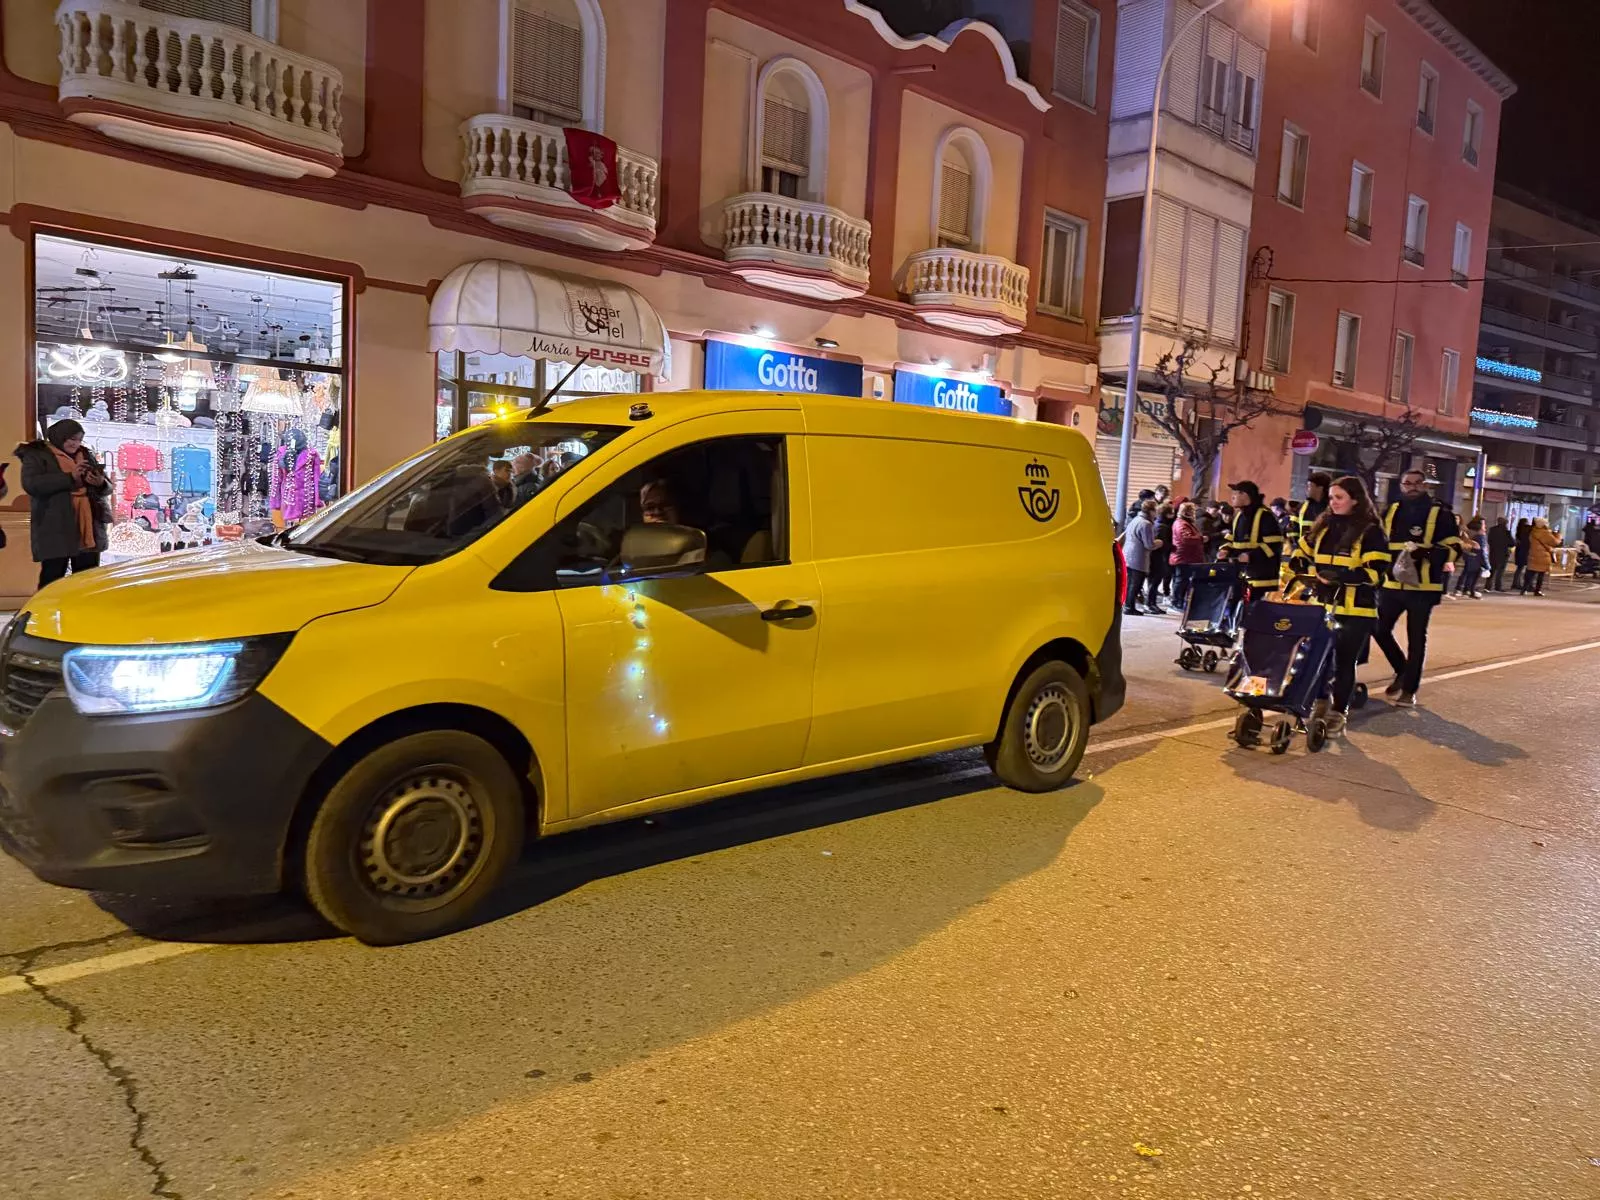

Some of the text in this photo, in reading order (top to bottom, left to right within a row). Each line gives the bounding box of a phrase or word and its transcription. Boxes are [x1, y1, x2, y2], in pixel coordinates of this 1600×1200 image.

[577, 300, 621, 320] Hogar
[597, 318, 625, 339] Piel
[526, 336, 572, 357] María
[758, 353, 818, 392] Gotta
[933, 381, 979, 412] Gotta
